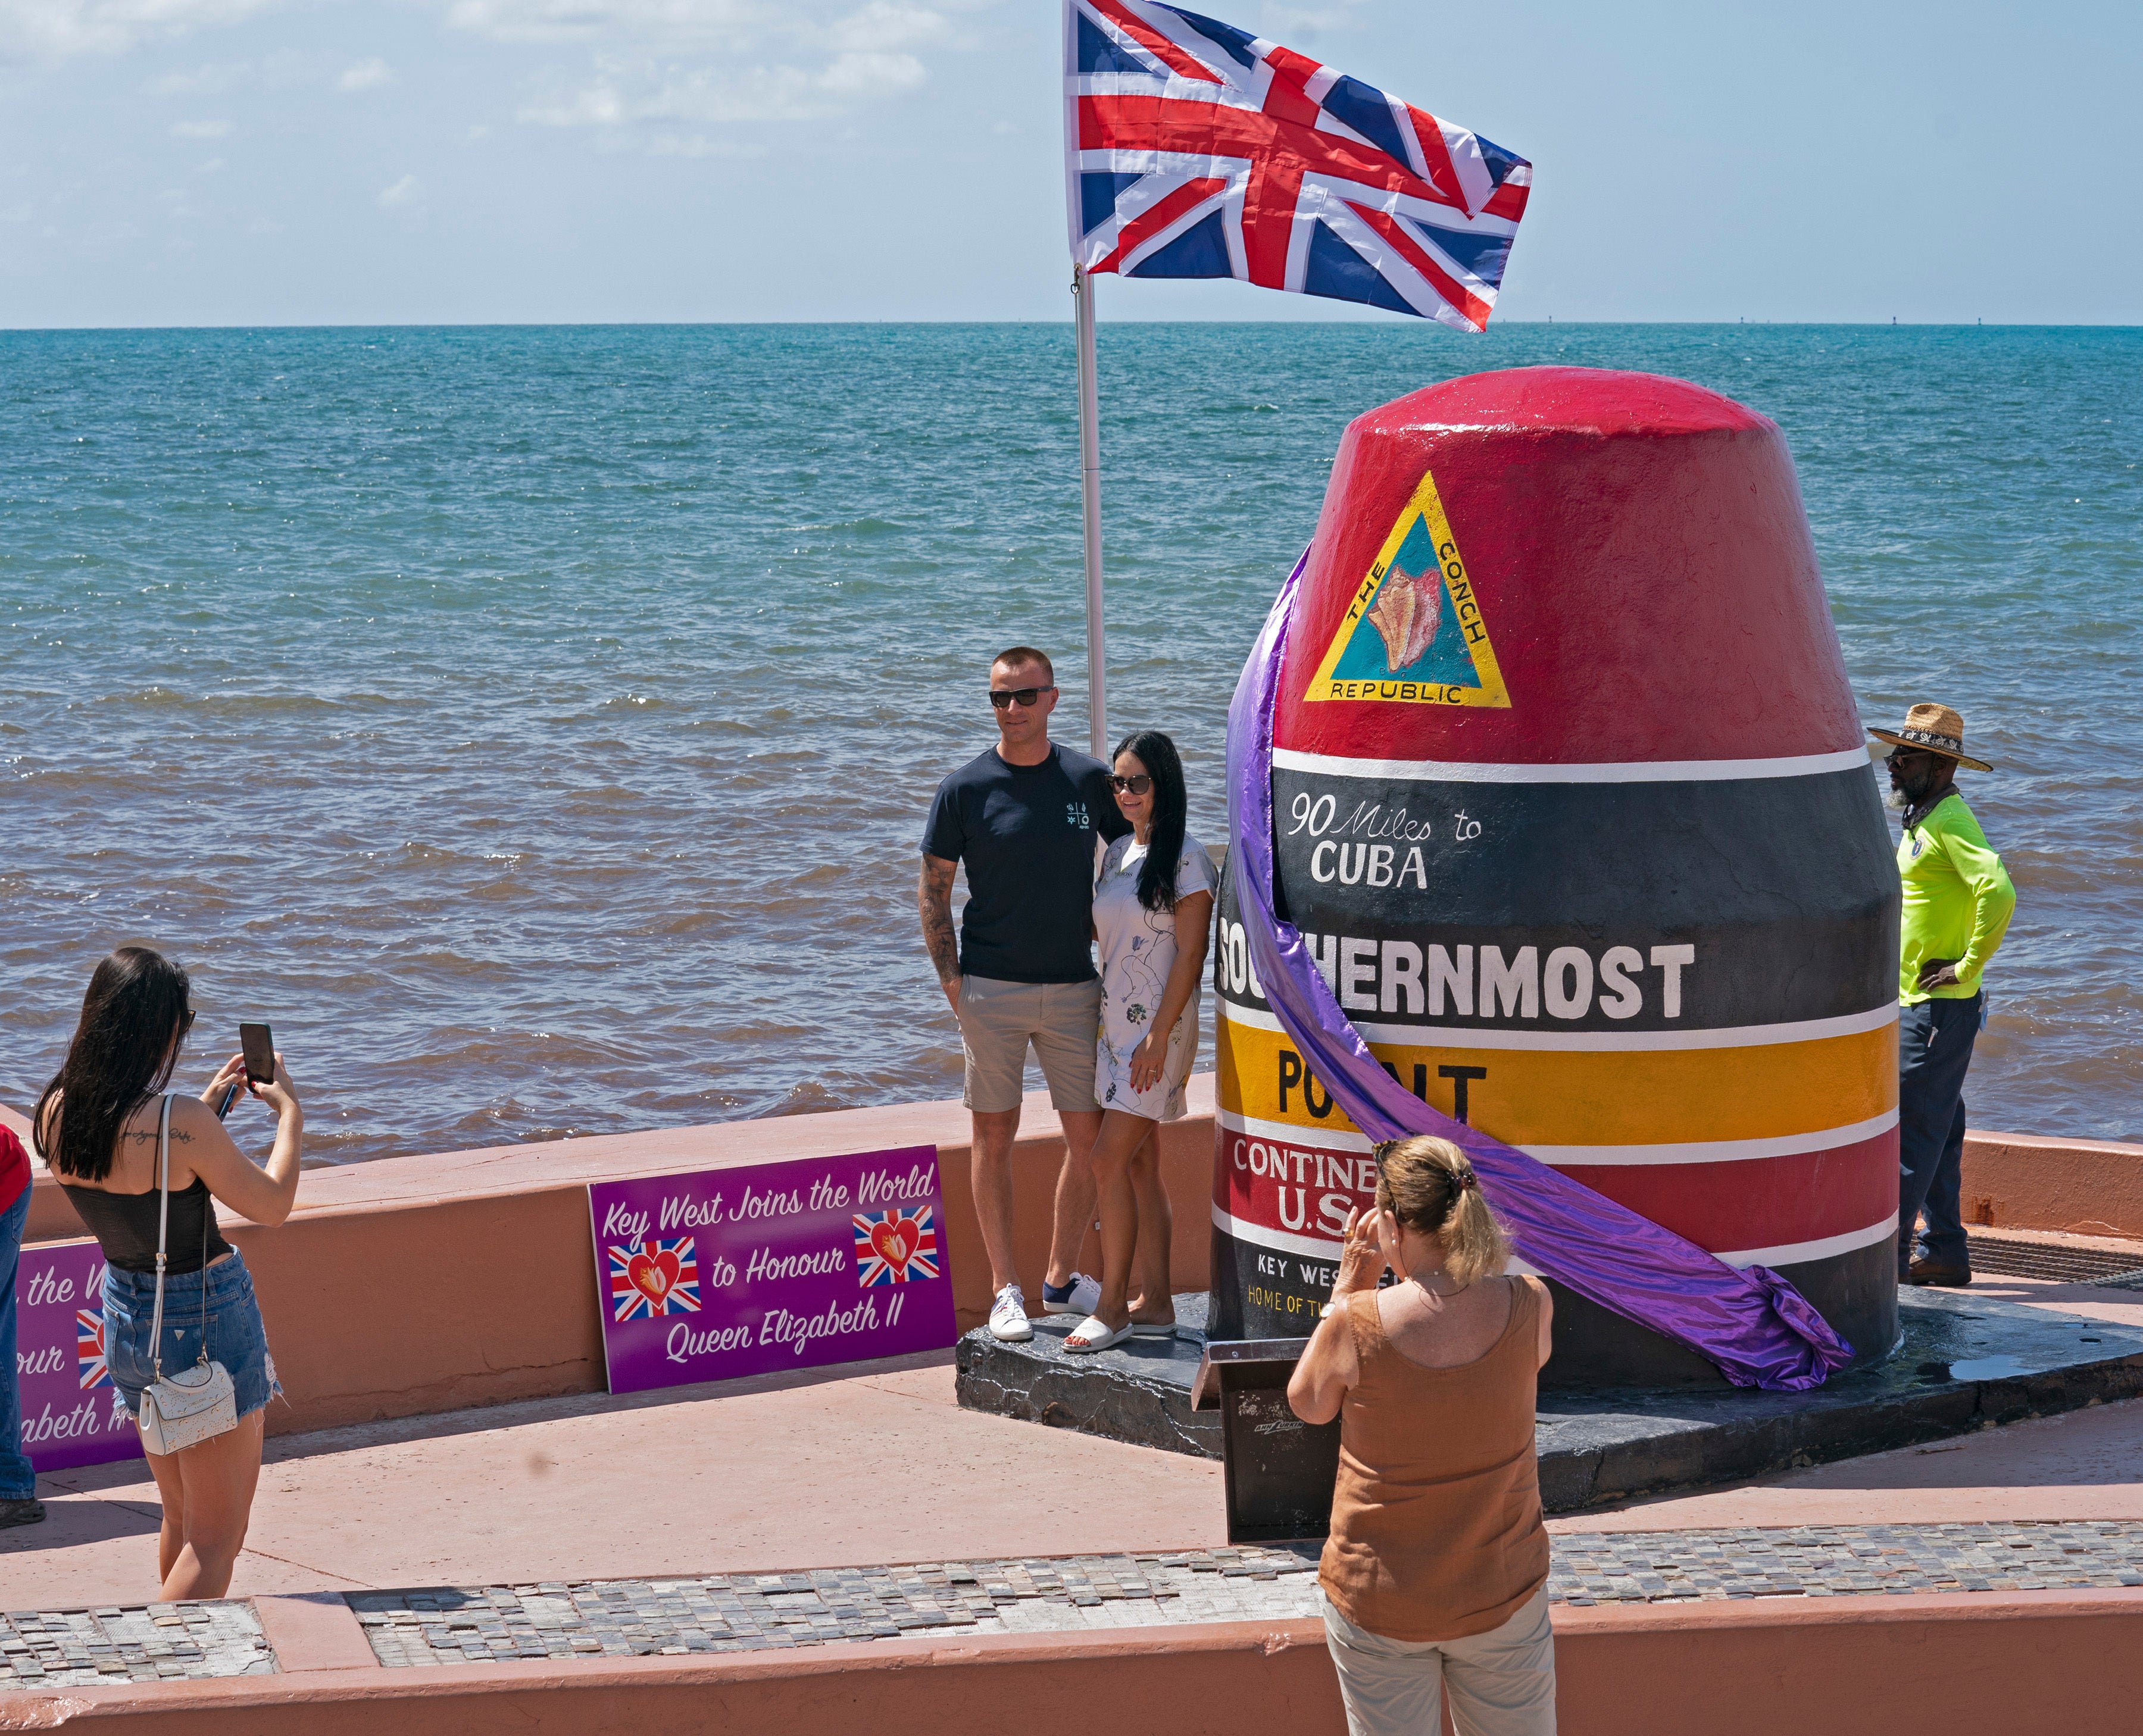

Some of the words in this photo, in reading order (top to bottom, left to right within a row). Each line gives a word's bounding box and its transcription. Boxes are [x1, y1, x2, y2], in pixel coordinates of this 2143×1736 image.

[1347, 562, 1385, 621] THE
[1440, 542, 1486, 644] CONCH
[1330, 683, 1461, 703] REPUBLIC
[1288, 792, 1336, 836] 90
[1330, 800, 1430, 840] Miles
[1454, 808, 1481, 840] to
[1311, 840, 1427, 889] CUBA
[1220, 917, 1695, 1019] SOHERNMOST
[1279, 1050, 1487, 1125] POT
[1234, 1139, 1377, 1193] CONTINE
[602, 1201, 651, 1253] Key
[660, 1193, 723, 1231] West
[729, 1185, 803, 1222] Joins
[810, 1173, 850, 1210] the
[858, 1162, 934, 1205] World
[27, 1265, 75, 1306] the
[713, 1255, 737, 1287] to
[746, 1246, 845, 1284] Honour
[1258, 1254, 1288, 1278] KEY
[1299, 1264, 1340, 1288] WES
[1248, 1284, 1282, 1310] HOME
[1287, 1296, 1303, 1314] OF
[666, 1322, 752, 1363] Queen
[759, 1294, 879, 1355] Elizabeth
[885, 1291, 904, 1328] II
